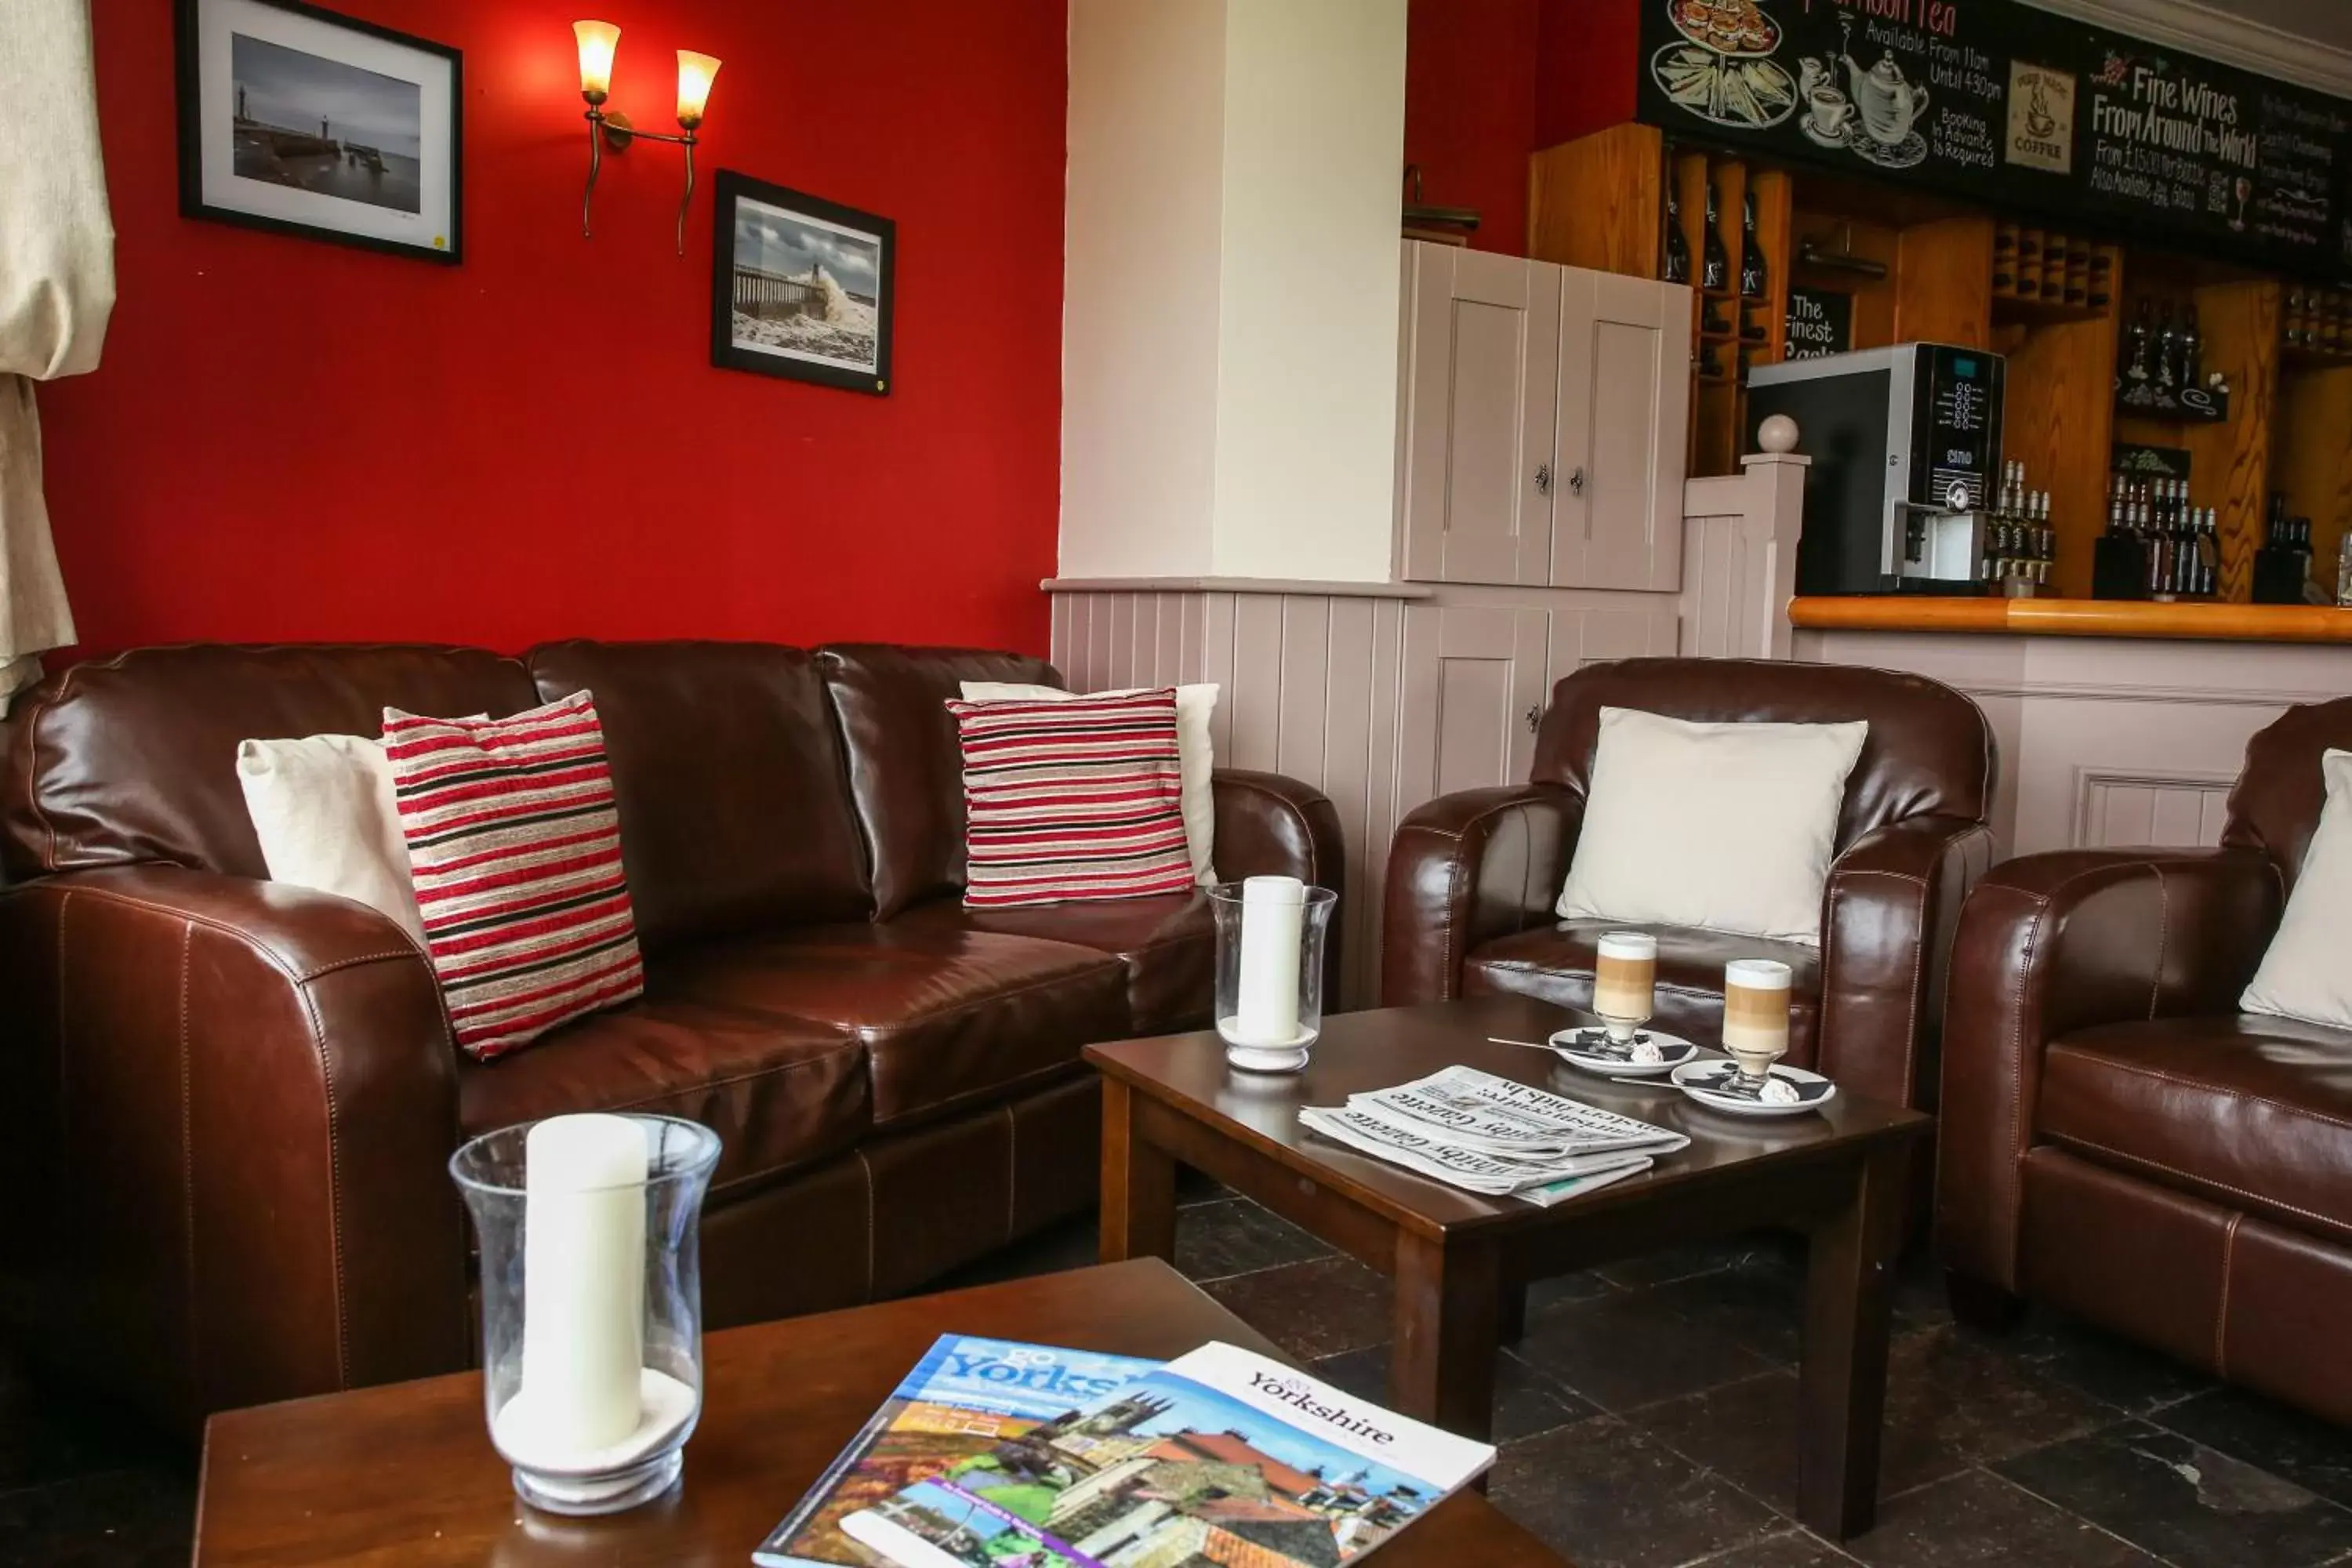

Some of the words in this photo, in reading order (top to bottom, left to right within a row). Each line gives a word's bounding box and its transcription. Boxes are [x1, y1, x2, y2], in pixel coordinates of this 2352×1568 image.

[1864, 17, 1926, 53] Available
[1928, 34, 1959, 64] From
[1929, 61, 1962, 91] Until
[2132, 65, 2178, 110] Fine
[2181, 76, 2238, 125] Wines
[1940, 106, 1986, 133] Booking
[2092, 93, 2142, 141] From
[2141, 104, 2202, 154] Around
[2203, 128, 2220, 154] The
[2219, 122, 2257, 169] World
[1944, 142, 1995, 168] Required
[2015, 136, 2061, 159] COFFEE
[2095, 138, 2122, 167] From
[1793, 294, 1823, 319] The
[1390, 1094, 1477, 1126] Gazette
[1345, 1112, 1430, 1148] Gazette
[1003, 1347, 1057, 1370] go
[947, 1352, 1149, 1399] Yorks
[1249, 1370, 1395, 1446] Yorkshire
